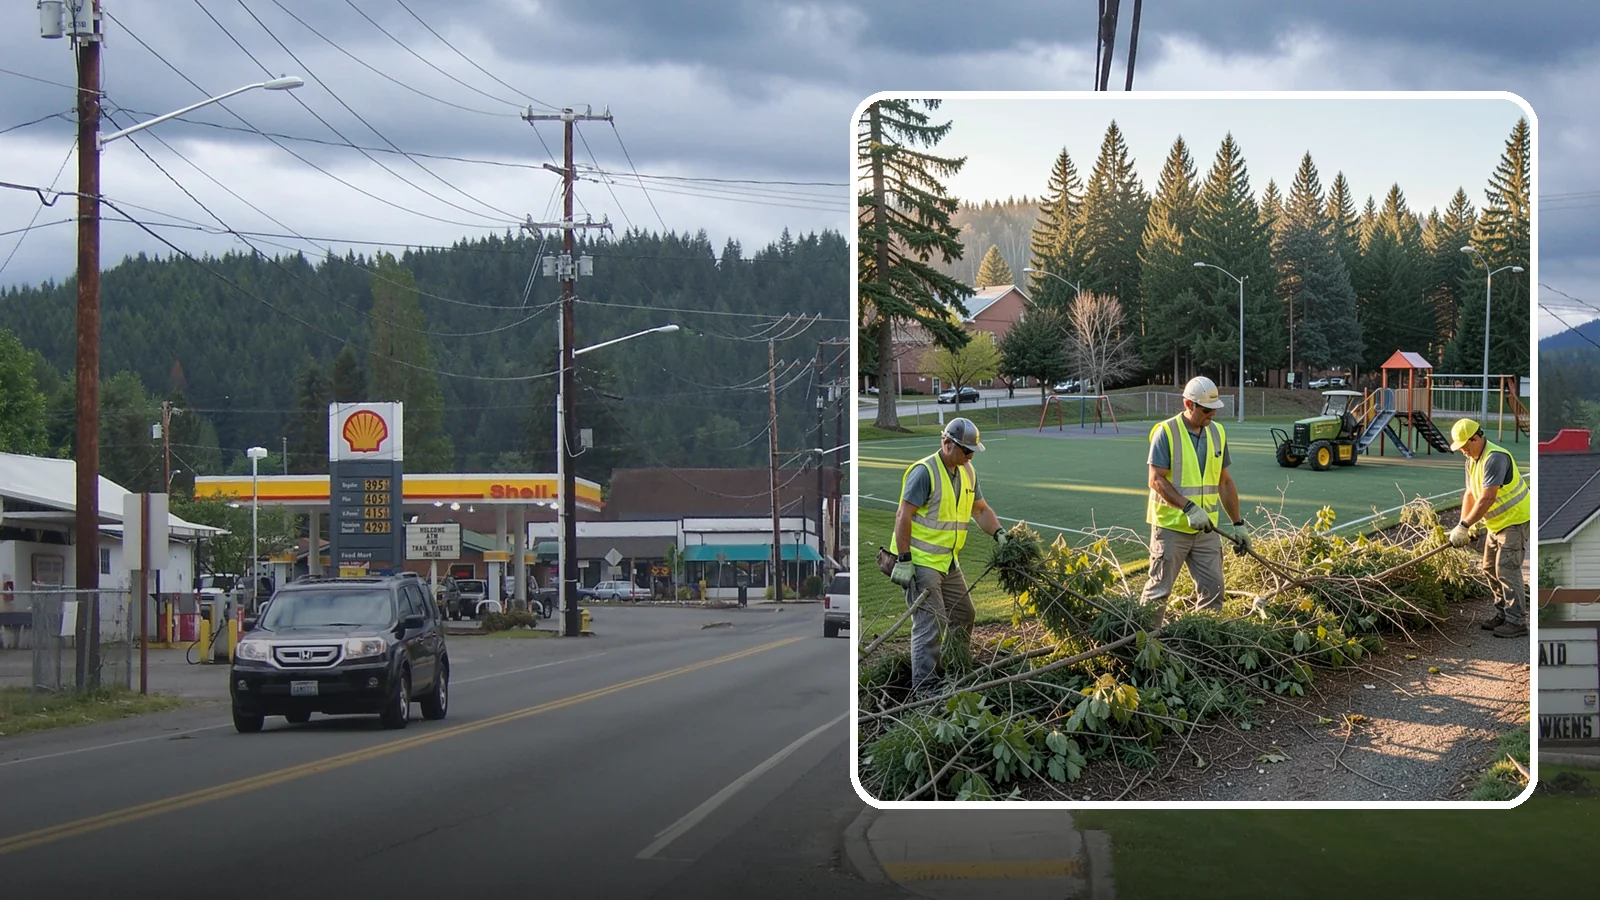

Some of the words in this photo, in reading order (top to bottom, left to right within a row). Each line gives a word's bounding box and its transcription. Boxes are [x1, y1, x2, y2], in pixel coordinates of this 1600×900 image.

[366, 480, 383, 490] 395
[490, 484, 547, 499] Shell
[366, 494, 383, 504] 405
[366, 508, 383, 518] 415
[366, 522, 383, 532] 429
[1539, 642, 1567, 666] AID
